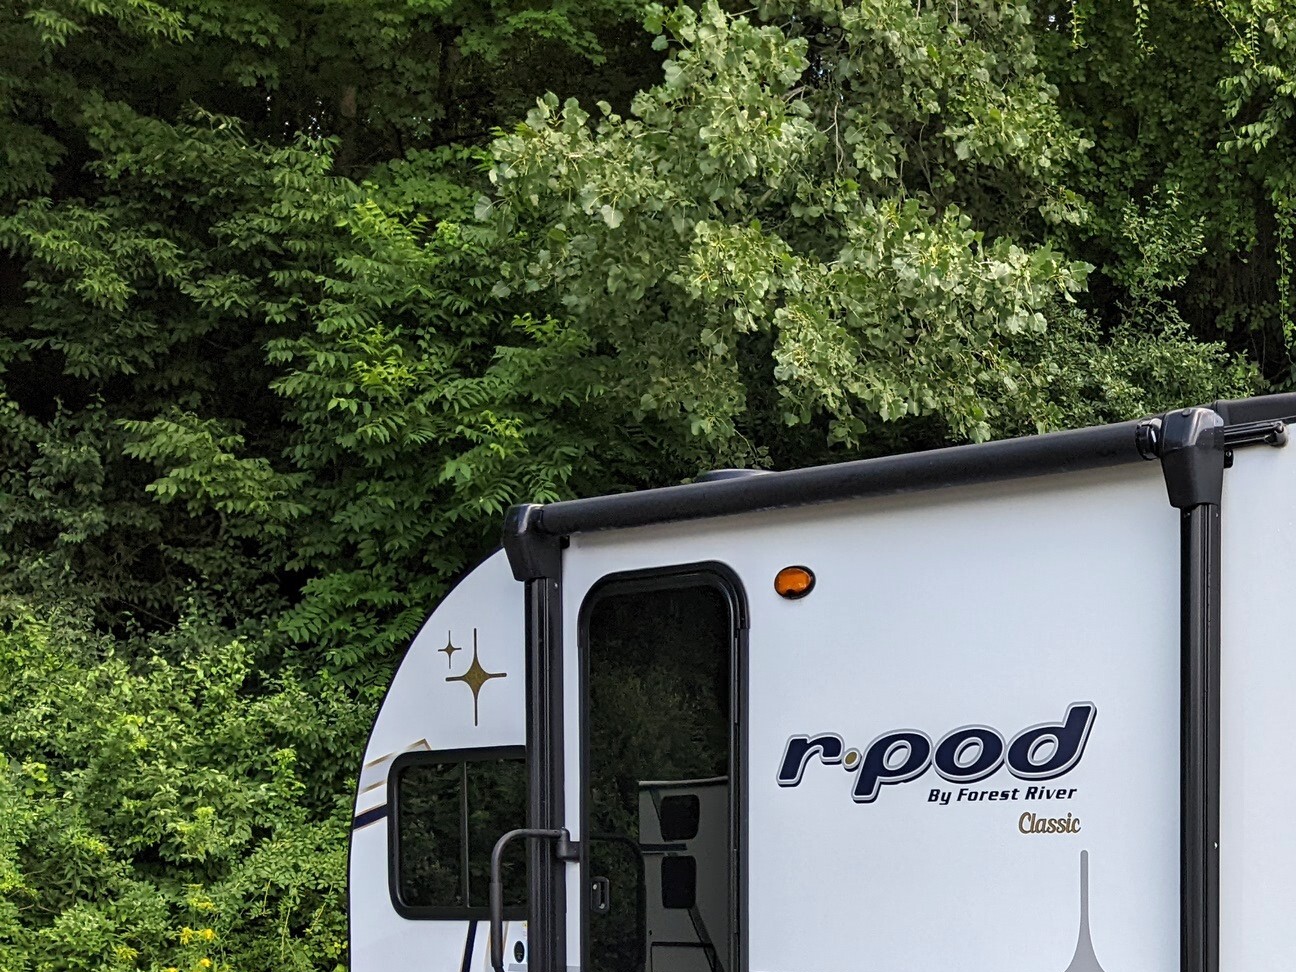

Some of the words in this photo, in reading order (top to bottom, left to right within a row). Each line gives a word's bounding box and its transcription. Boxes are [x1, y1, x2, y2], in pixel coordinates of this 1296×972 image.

[927, 788, 951, 805] By
[956, 787, 1019, 802] Forest
[1025, 786, 1077, 800] River
[1018, 811, 1081, 834] Classic
